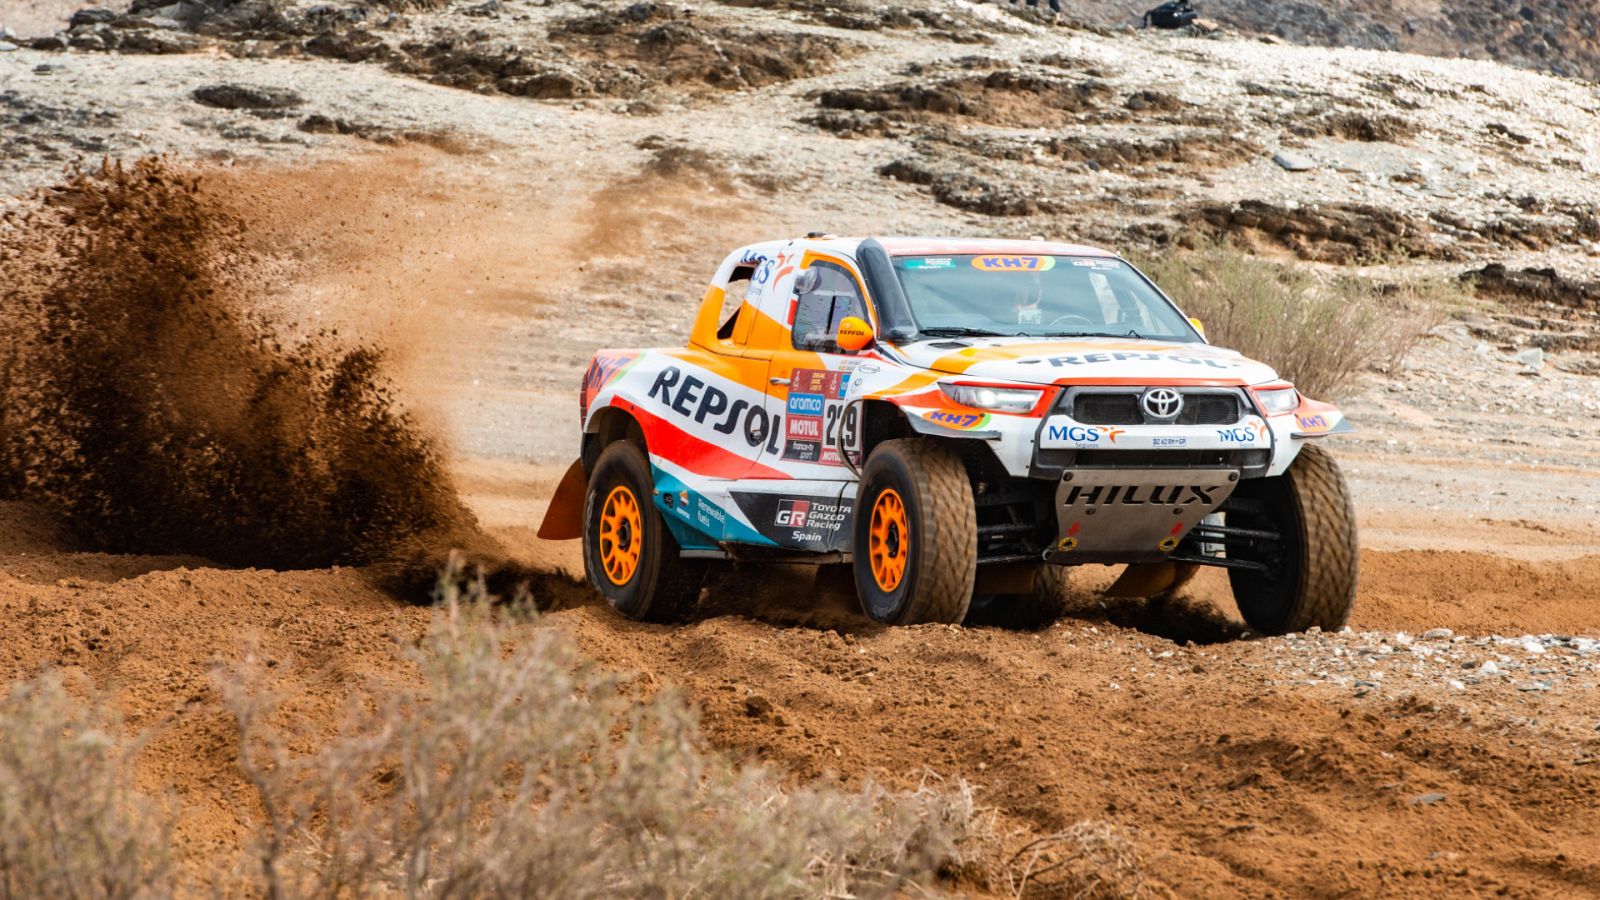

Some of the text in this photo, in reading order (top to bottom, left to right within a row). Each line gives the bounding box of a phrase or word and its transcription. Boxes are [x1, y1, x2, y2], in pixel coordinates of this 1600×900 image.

[1048, 353, 1227, 369] REPSOL
[648, 365, 781, 455] REPSOL
[790, 397, 821, 411] aramco
[930, 411, 978, 427] KH-7
[790, 419, 819, 436] MOTUL
[1049, 425, 1100, 441] MGS
[1217, 427, 1255, 442] MGS
[1064, 485, 1220, 506] HILUX
[698, 498, 725, 524] Renewable
[812, 502, 852, 513] TOYOTA
[697, 510, 710, 527] fuels
[777, 510, 806, 526] GR
[809, 511, 845, 521] GAZOO
[806, 519, 841, 531] Racing
[792, 531, 822, 542] Spain
